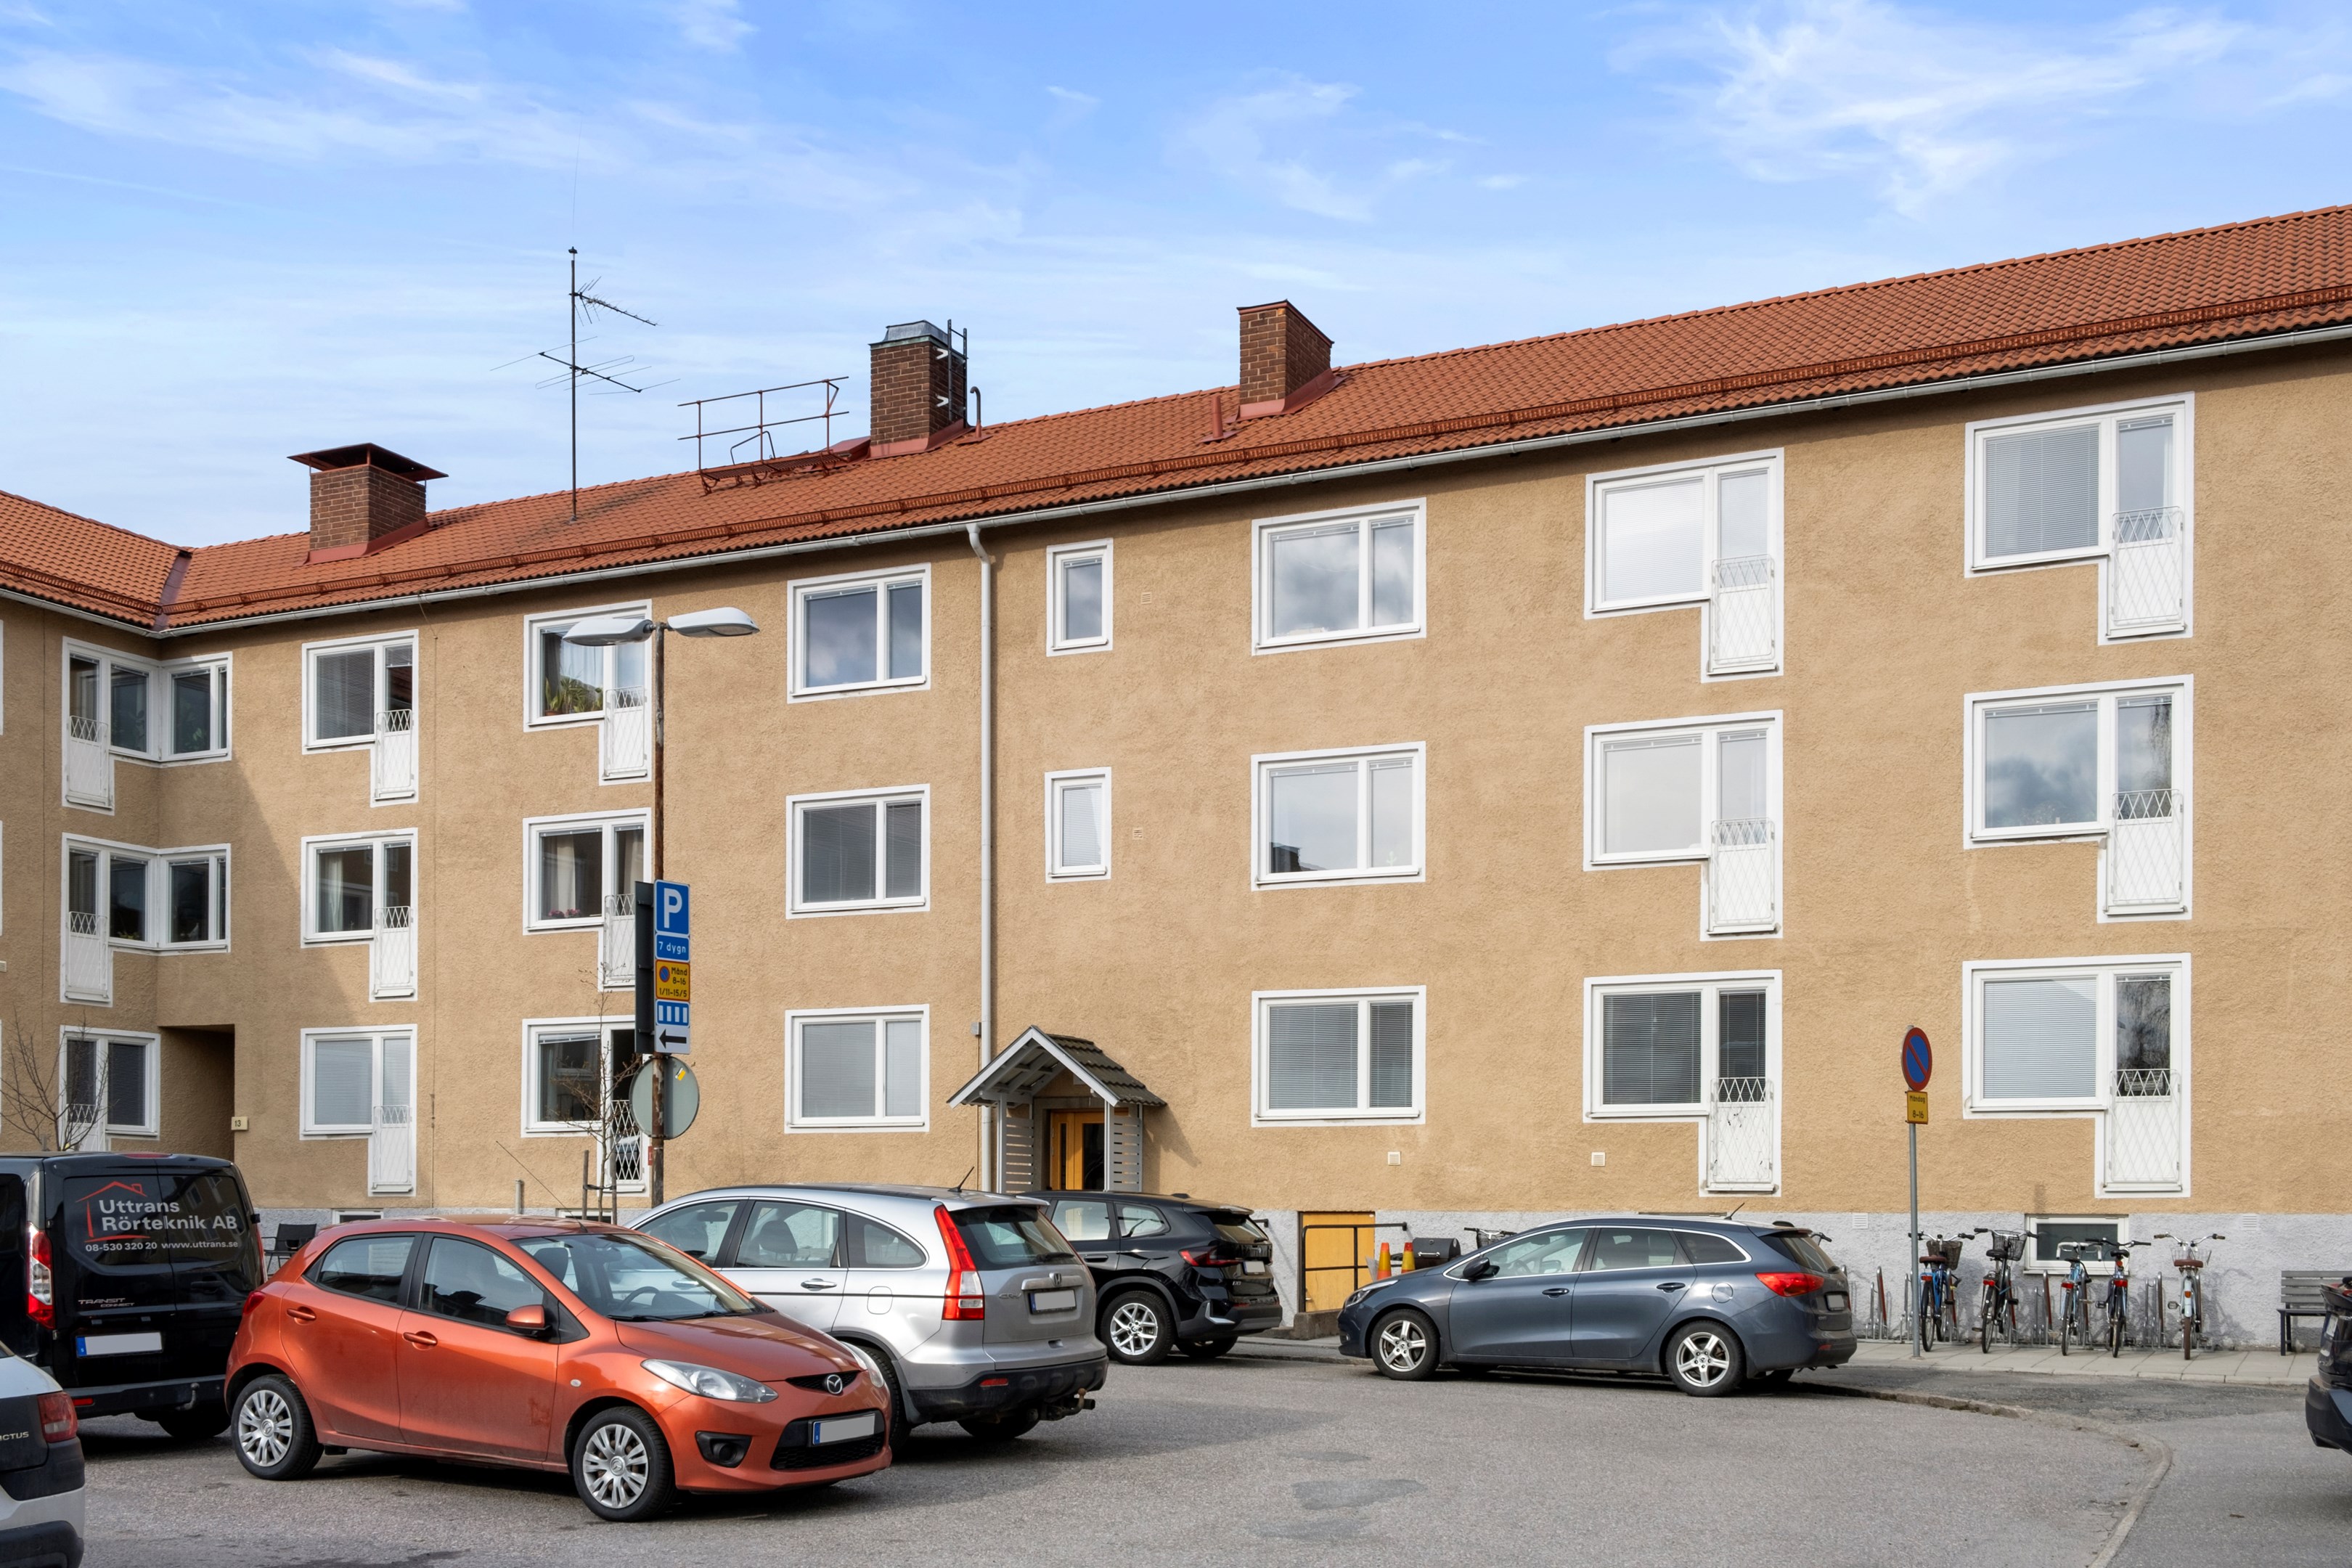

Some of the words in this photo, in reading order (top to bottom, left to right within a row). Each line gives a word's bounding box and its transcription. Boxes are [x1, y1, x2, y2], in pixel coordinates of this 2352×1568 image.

[663, 888, 682, 928] P
[658, 941, 663, 950] 7
[666, 942, 686, 955] dygn
[671, 966, 687, 976] Månd
[672, 976, 687, 986] 8-16
[658, 987, 687, 997] 1/11-15/5
[1913, 1110, 1924, 1119] 8-16
[98, 1199, 180, 1214] Uttrans
[102, 1215, 207, 1231] Rörteknik
[212, 1215, 237, 1230] AB
[85, 1243, 123, 1252] 08-530
[124, 1242, 144, 1251] 320
[145, 1241, 158, 1250] 20
[161, 1241, 239, 1249] www.uttrans.se
